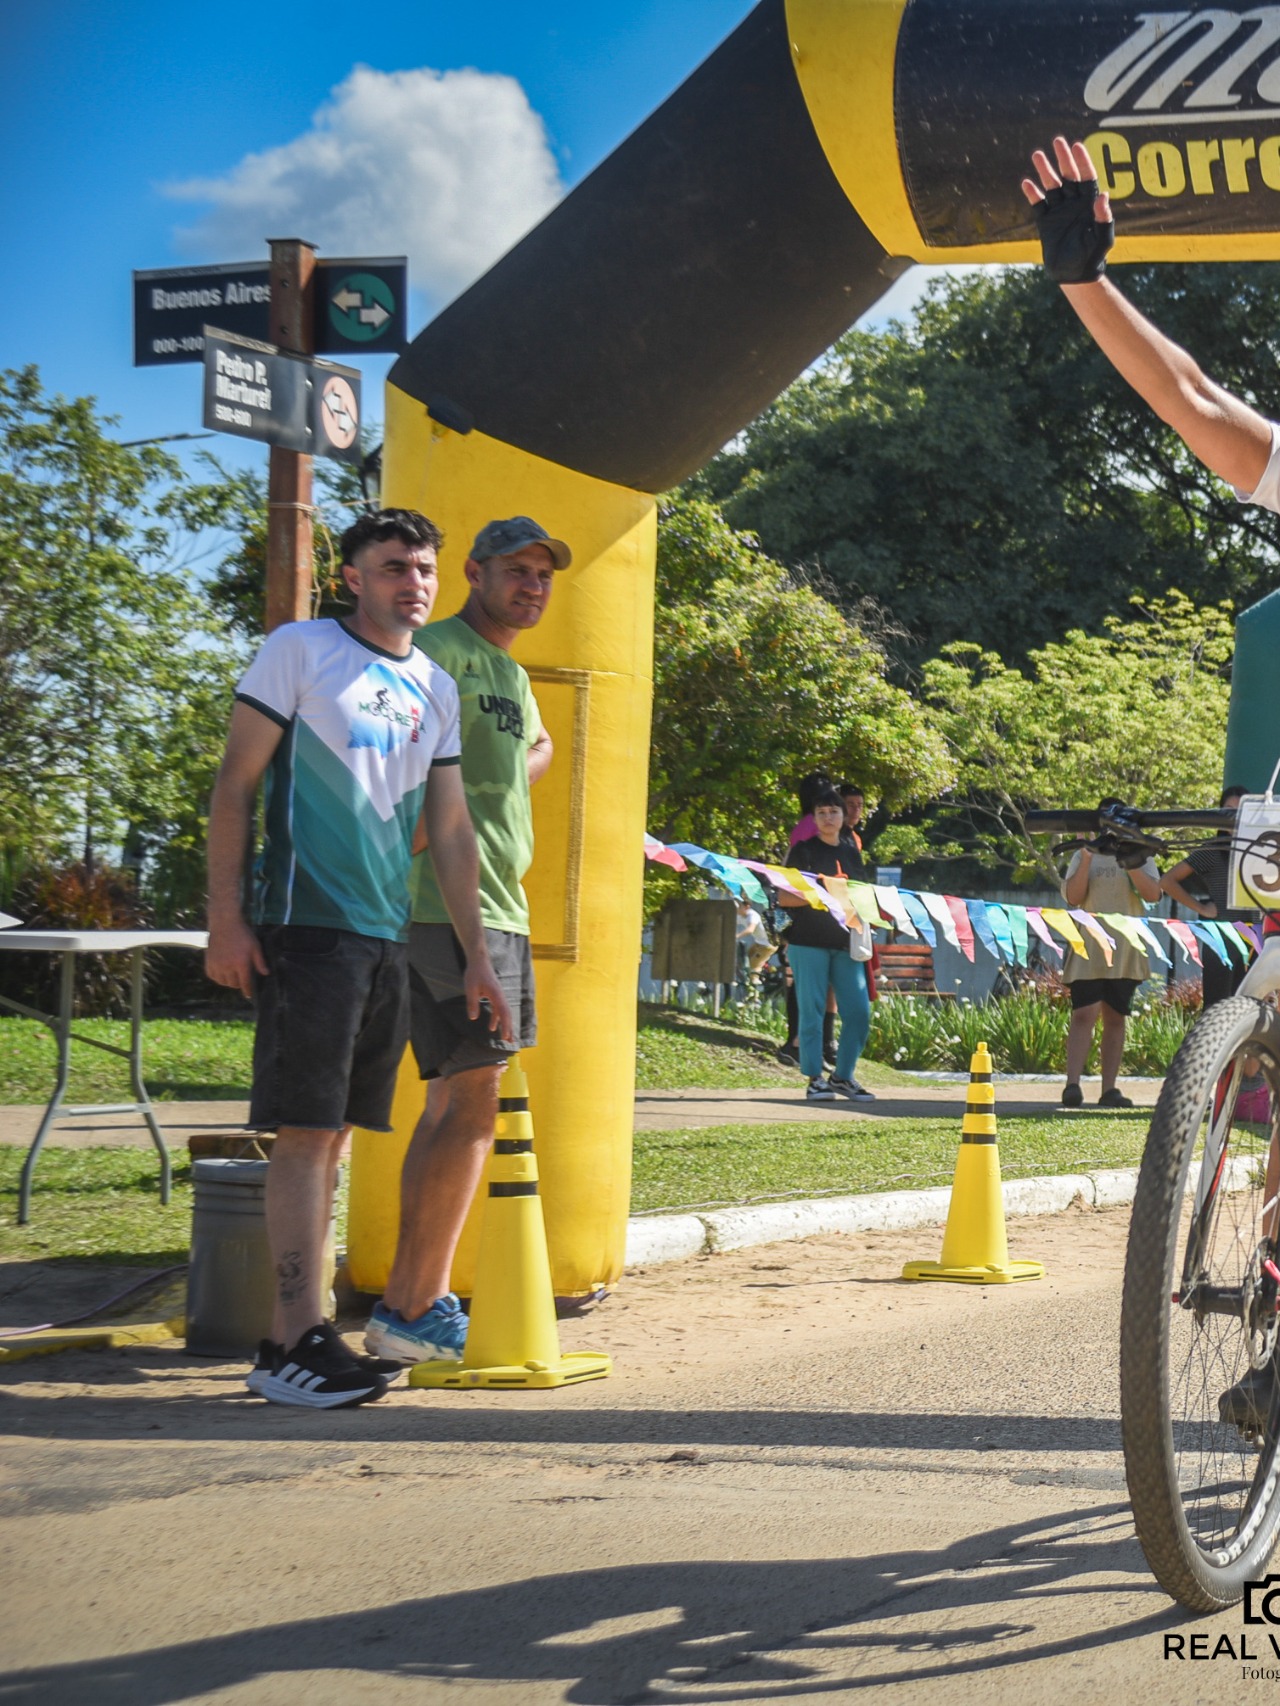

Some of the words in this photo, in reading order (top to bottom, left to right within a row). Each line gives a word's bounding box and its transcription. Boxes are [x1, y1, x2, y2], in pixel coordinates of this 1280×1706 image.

[152, 288, 222, 310] Buenos
[224, 282, 271, 305] Aires
[216, 349, 254, 382] Pedro
[255, 360, 268, 386] P.
